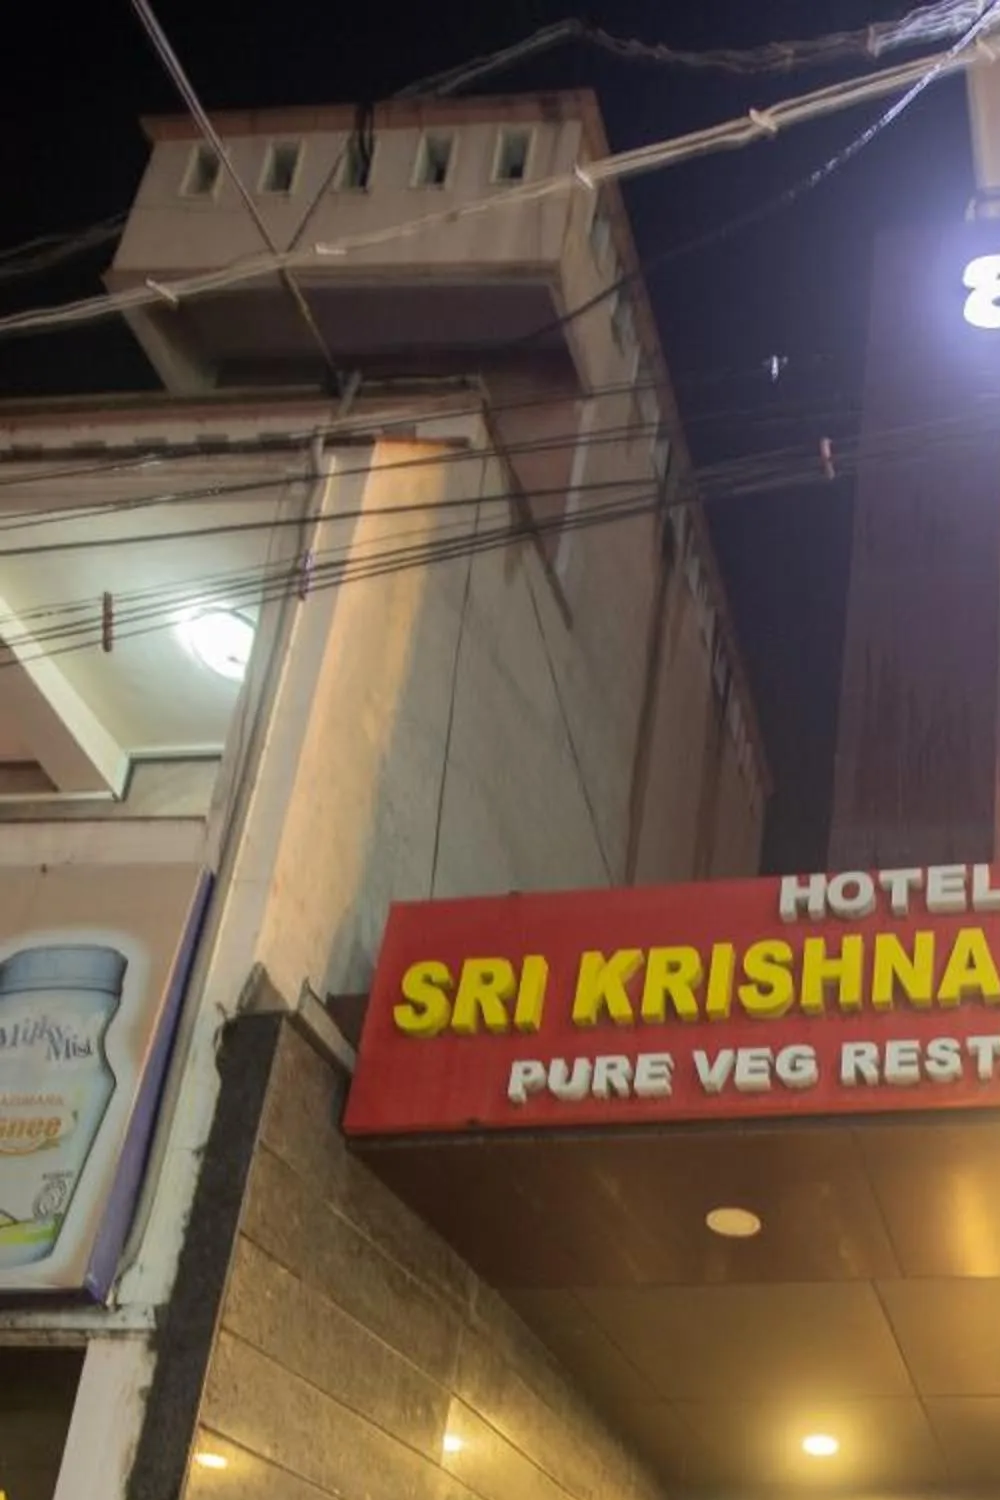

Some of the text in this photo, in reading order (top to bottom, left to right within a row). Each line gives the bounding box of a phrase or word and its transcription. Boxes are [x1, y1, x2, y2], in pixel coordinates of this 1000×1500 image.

[393, 954, 548, 1036] SRI
[507, 1052, 674, 1104] PURE
[691, 1044, 820, 1096] VEG
